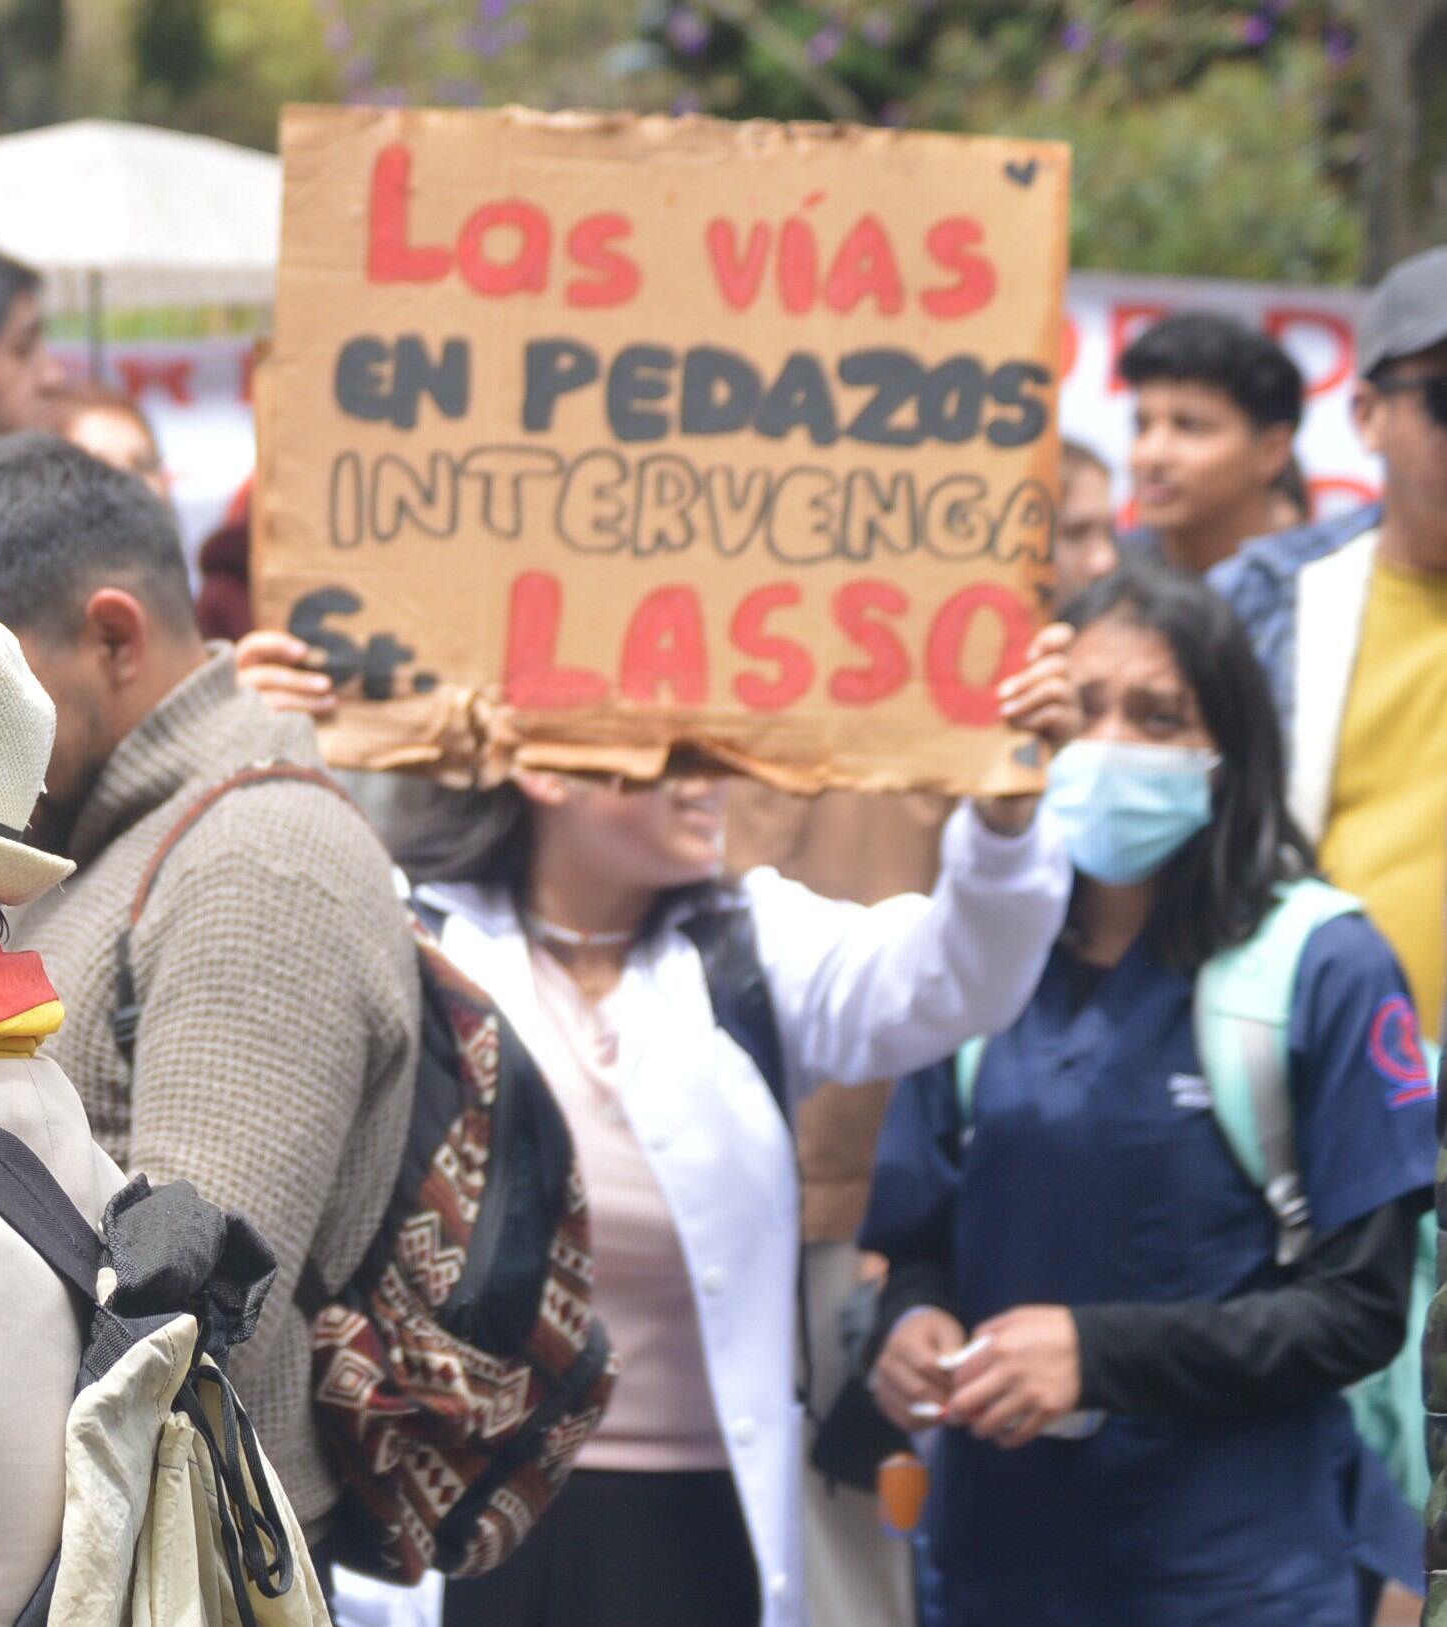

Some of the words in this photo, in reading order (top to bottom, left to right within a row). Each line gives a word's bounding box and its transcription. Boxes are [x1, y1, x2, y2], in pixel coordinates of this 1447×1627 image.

[366, 142, 642, 310] Las
[334, 335, 471, 431] EN
[522, 337, 1053, 450] PEDAZOS
[329, 444, 1057, 564] INTERVENGA
[502, 569, 1039, 728] LASSO
